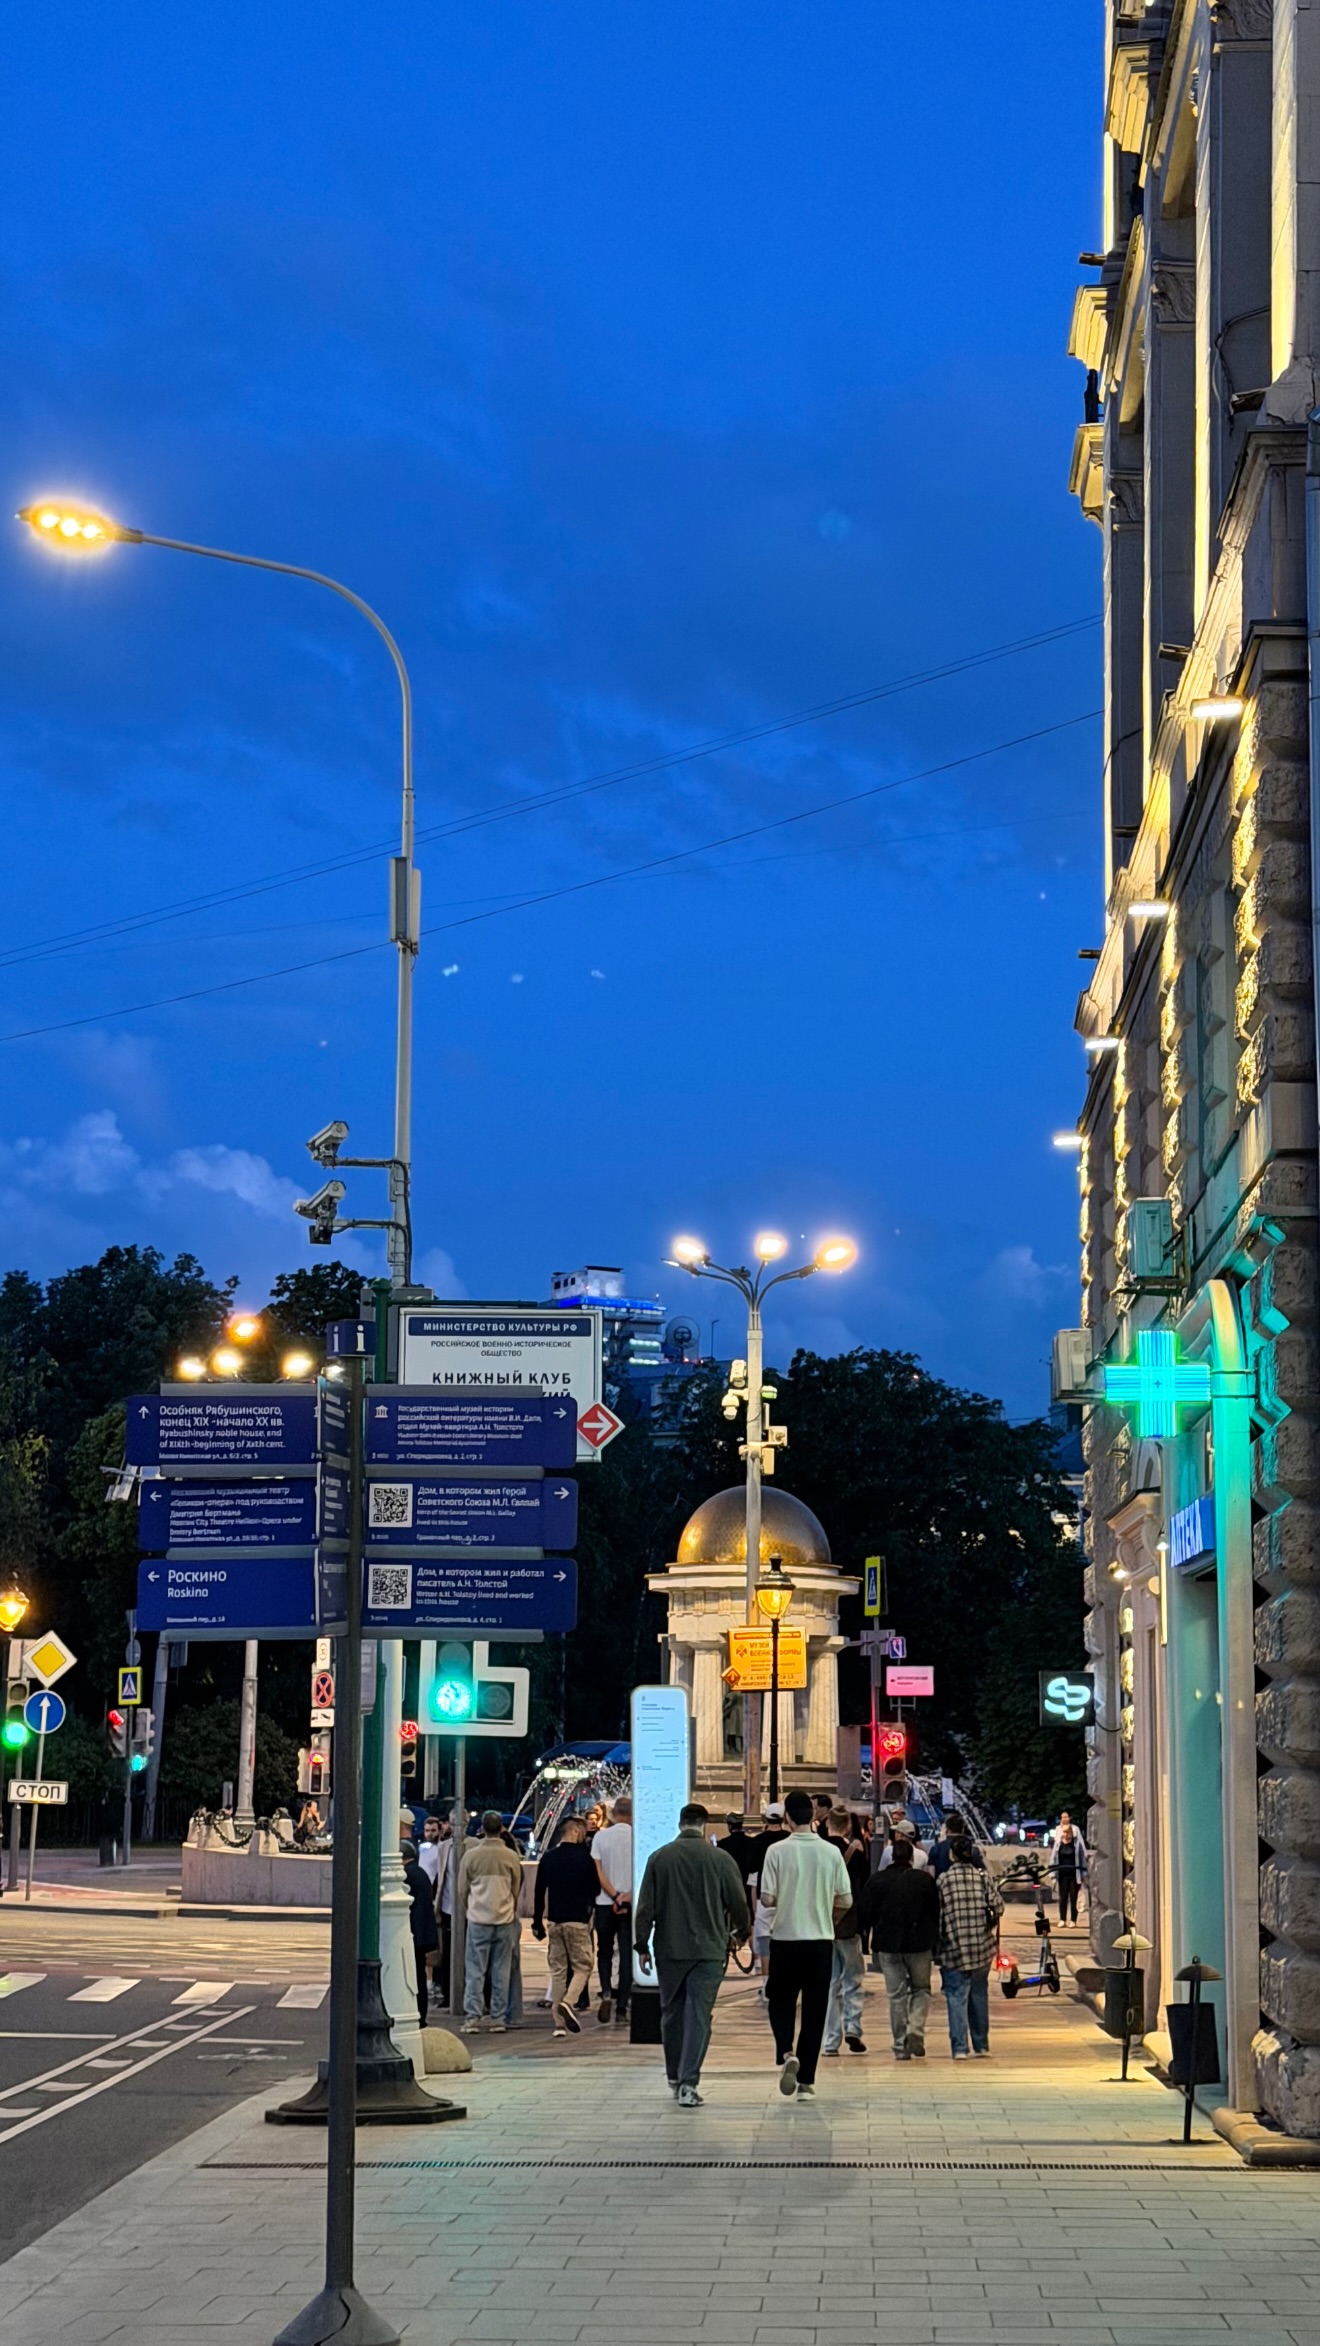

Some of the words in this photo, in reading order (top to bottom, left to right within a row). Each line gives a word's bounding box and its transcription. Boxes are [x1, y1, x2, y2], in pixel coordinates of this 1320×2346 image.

[423, 1322, 505, 1331] МИНИСТЕРСТВО
[508, 1322, 560, 1332] КУЛЬТУРЫ
[563, 1323, 578, 1332] РФ
[430, 1339, 481, 1348] РОССИЙСКОЕ
[432, 1370, 522, 1385] КНИЖНЫЙ
[529, 1372, 572, 1385] КЛУБ
[159, 1404, 204, 1415] Особняк
[205, 1404, 283, 1417] Рябушинского,
[159, 1418, 191, 1428] конец
[417, 1486, 438, 1496] Дом,
[445, 1488, 482, 1496] котором
[502, 1487, 527, 1497] Герой
[417, 1498, 464, 1507] Советского
[464, 1498, 491, 1507] Союза
[1170, 1498, 1204, 1568] АПТЕКА
[168, 1569, 227, 1583] Роскино
[445, 1569, 482, 1577] котором
[483, 1569, 501, 1577] жил
[509, 1568, 545, 1578] работал
[474, 1579, 508, 1588] Толстой
[167, 1586, 209, 1598] Roskino
[16, 1784, 61, 1800] СТОП
